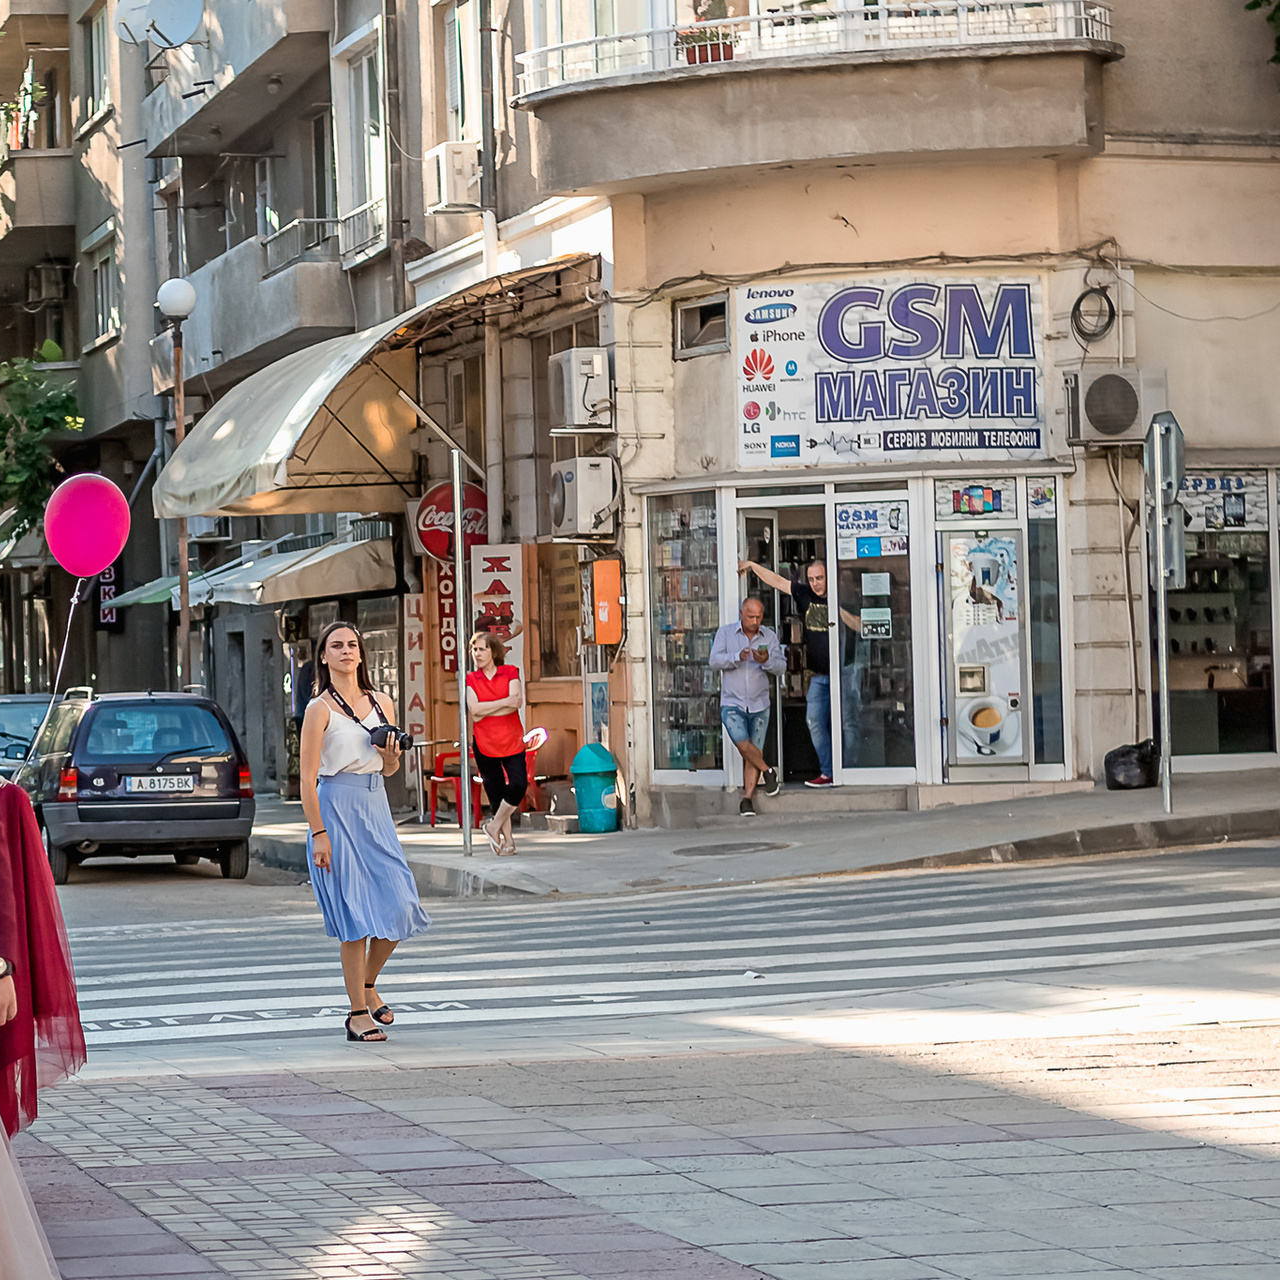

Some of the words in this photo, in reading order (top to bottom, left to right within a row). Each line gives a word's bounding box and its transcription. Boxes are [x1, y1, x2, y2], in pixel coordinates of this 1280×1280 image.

[746, 288, 795, 299] lenovo
[749, 307, 795, 321] SAMSUNG
[817, 282, 1036, 364] GSM
[762, 329, 806, 342] iPhone
[742, 383, 776, 393] HUAWEI
[815, 366, 1037, 423] МАГАЗИН
[743, 422, 761, 434] LG
[886, 431, 926, 448] СЕРВИЗ
[931, 431, 979, 447] МОБИЛНИ
[983, 430, 1037, 447] ТЕЛЕФОНИ
[744, 442, 767, 450] SONY
[838, 509, 878, 521] GSM
